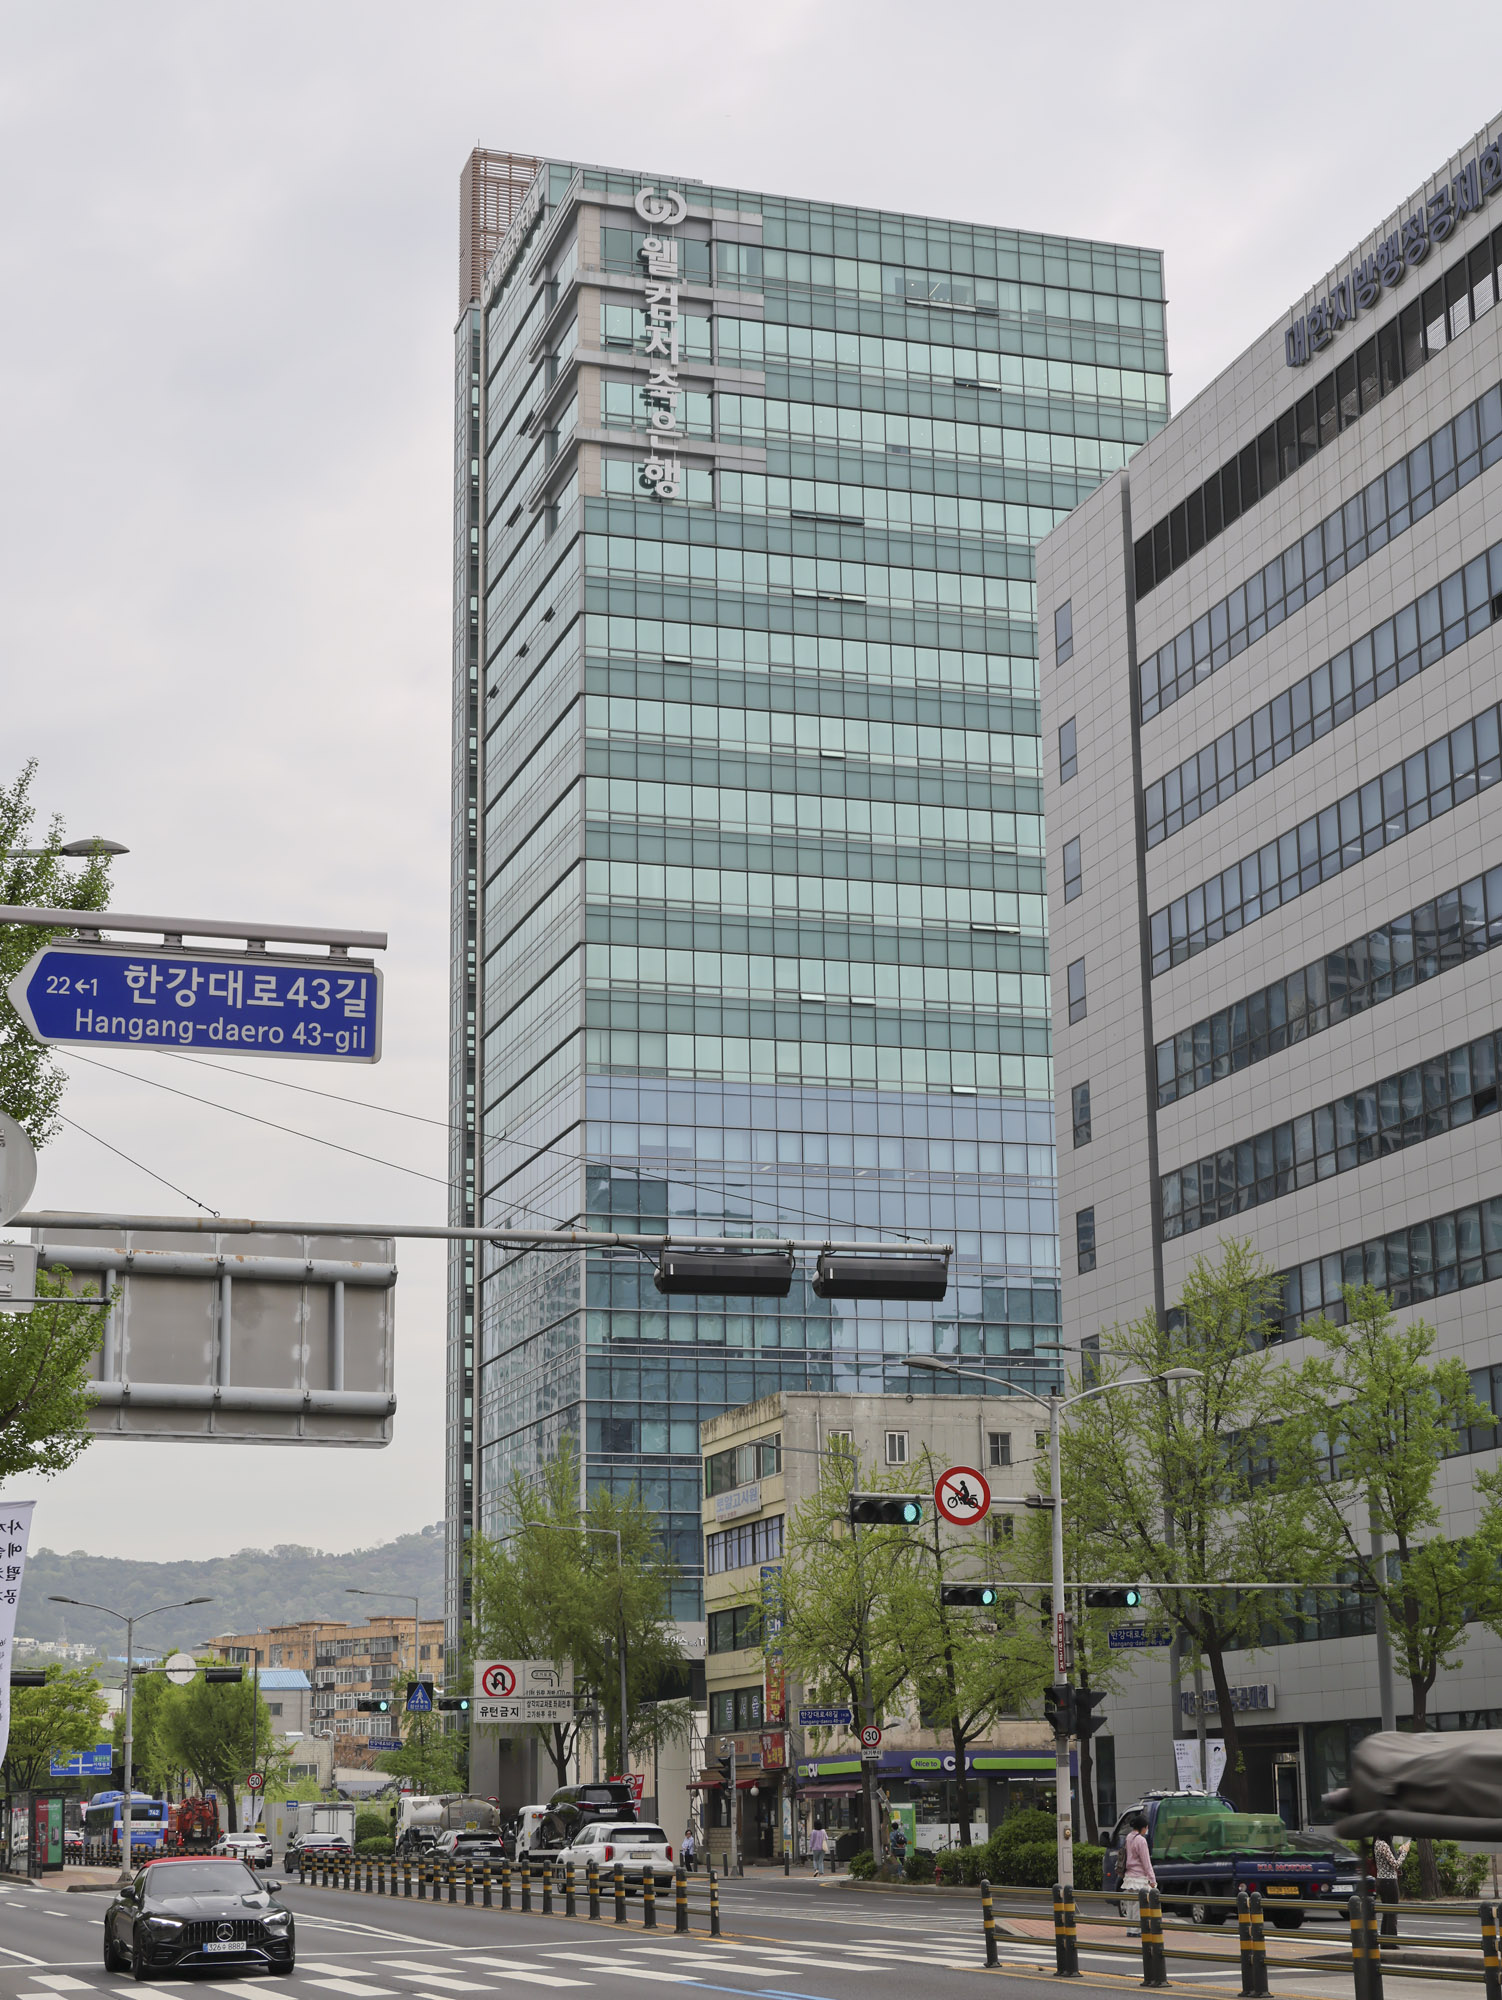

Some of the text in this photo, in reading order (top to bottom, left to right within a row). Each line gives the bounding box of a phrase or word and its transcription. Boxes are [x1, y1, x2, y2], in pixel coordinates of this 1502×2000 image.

[641, 237, 682, 499] 웰컴저축은행
[46, 964, 367, 1019] 22 1 한강대로43길
[75, 1008, 366, 1054] Hangang-daero 43-gil
[479, 1706, 519, 1718] 유턴금지
[864, 1730, 878, 1741] 30
[807, 1763, 818, 1778] CU
[250, 1776, 260, 1786] 50
[1257, 1863, 1313, 1872] KIA MOTORS
[228, 1942, 245, 1950] 8882
